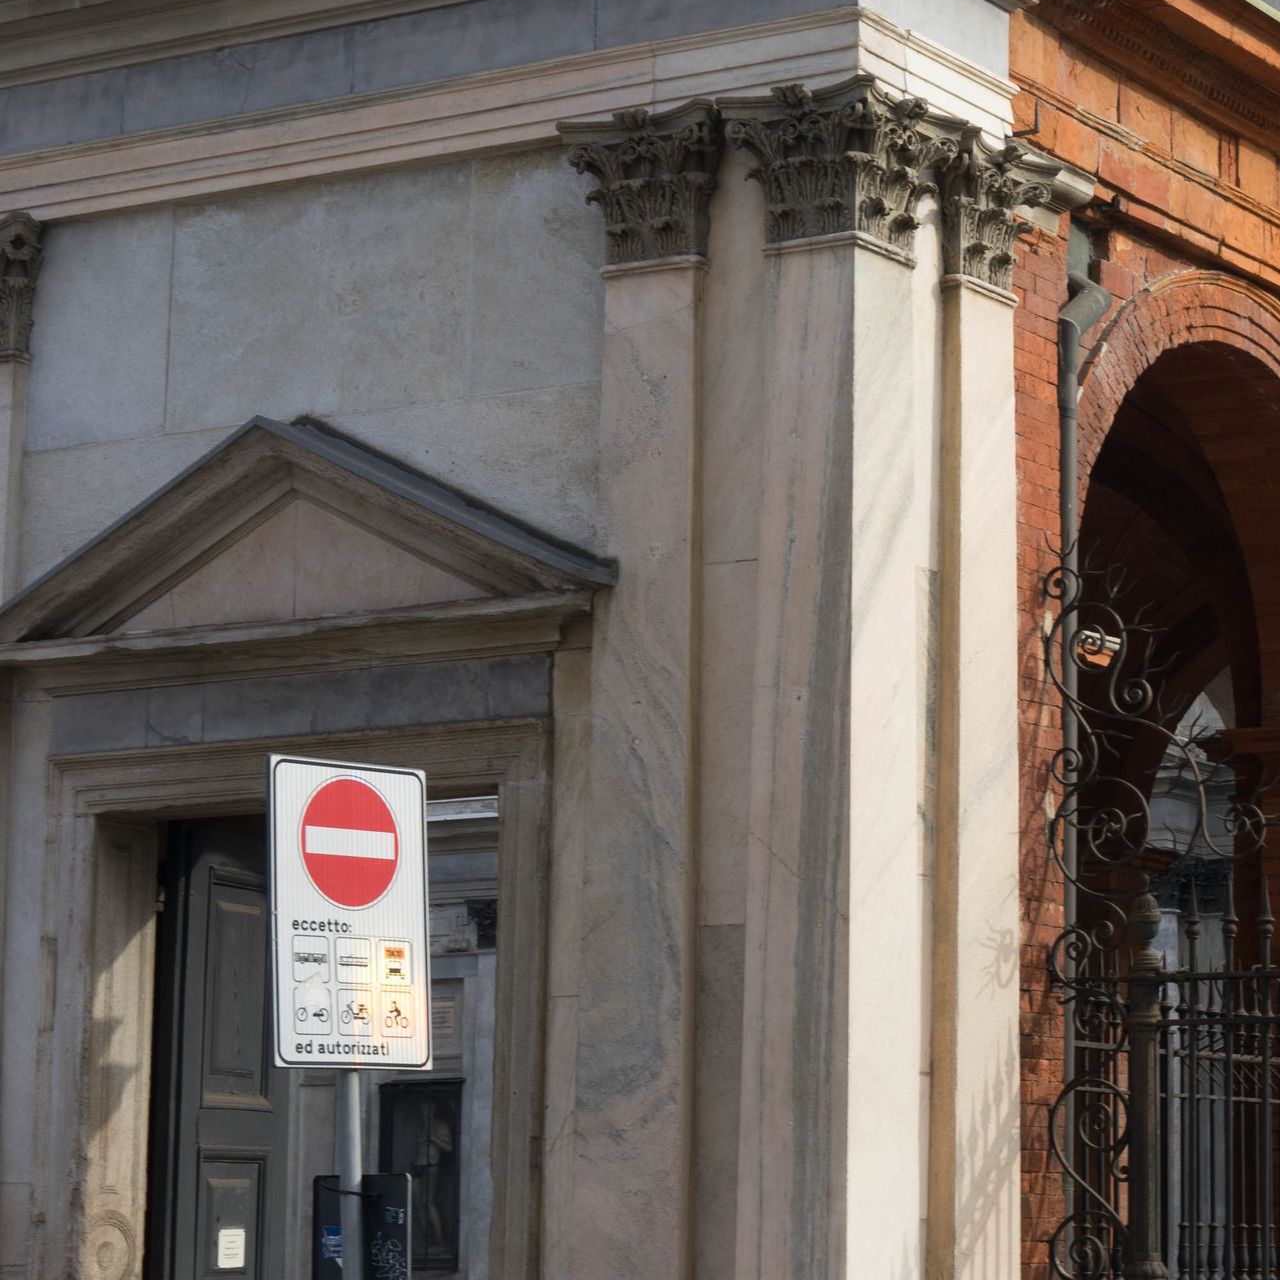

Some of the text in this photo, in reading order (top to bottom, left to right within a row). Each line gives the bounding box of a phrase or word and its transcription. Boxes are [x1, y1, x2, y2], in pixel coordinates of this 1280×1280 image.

[292, 919, 352, 933] eccetto:
[295, 1040, 389, 1056] ed autorizzati
